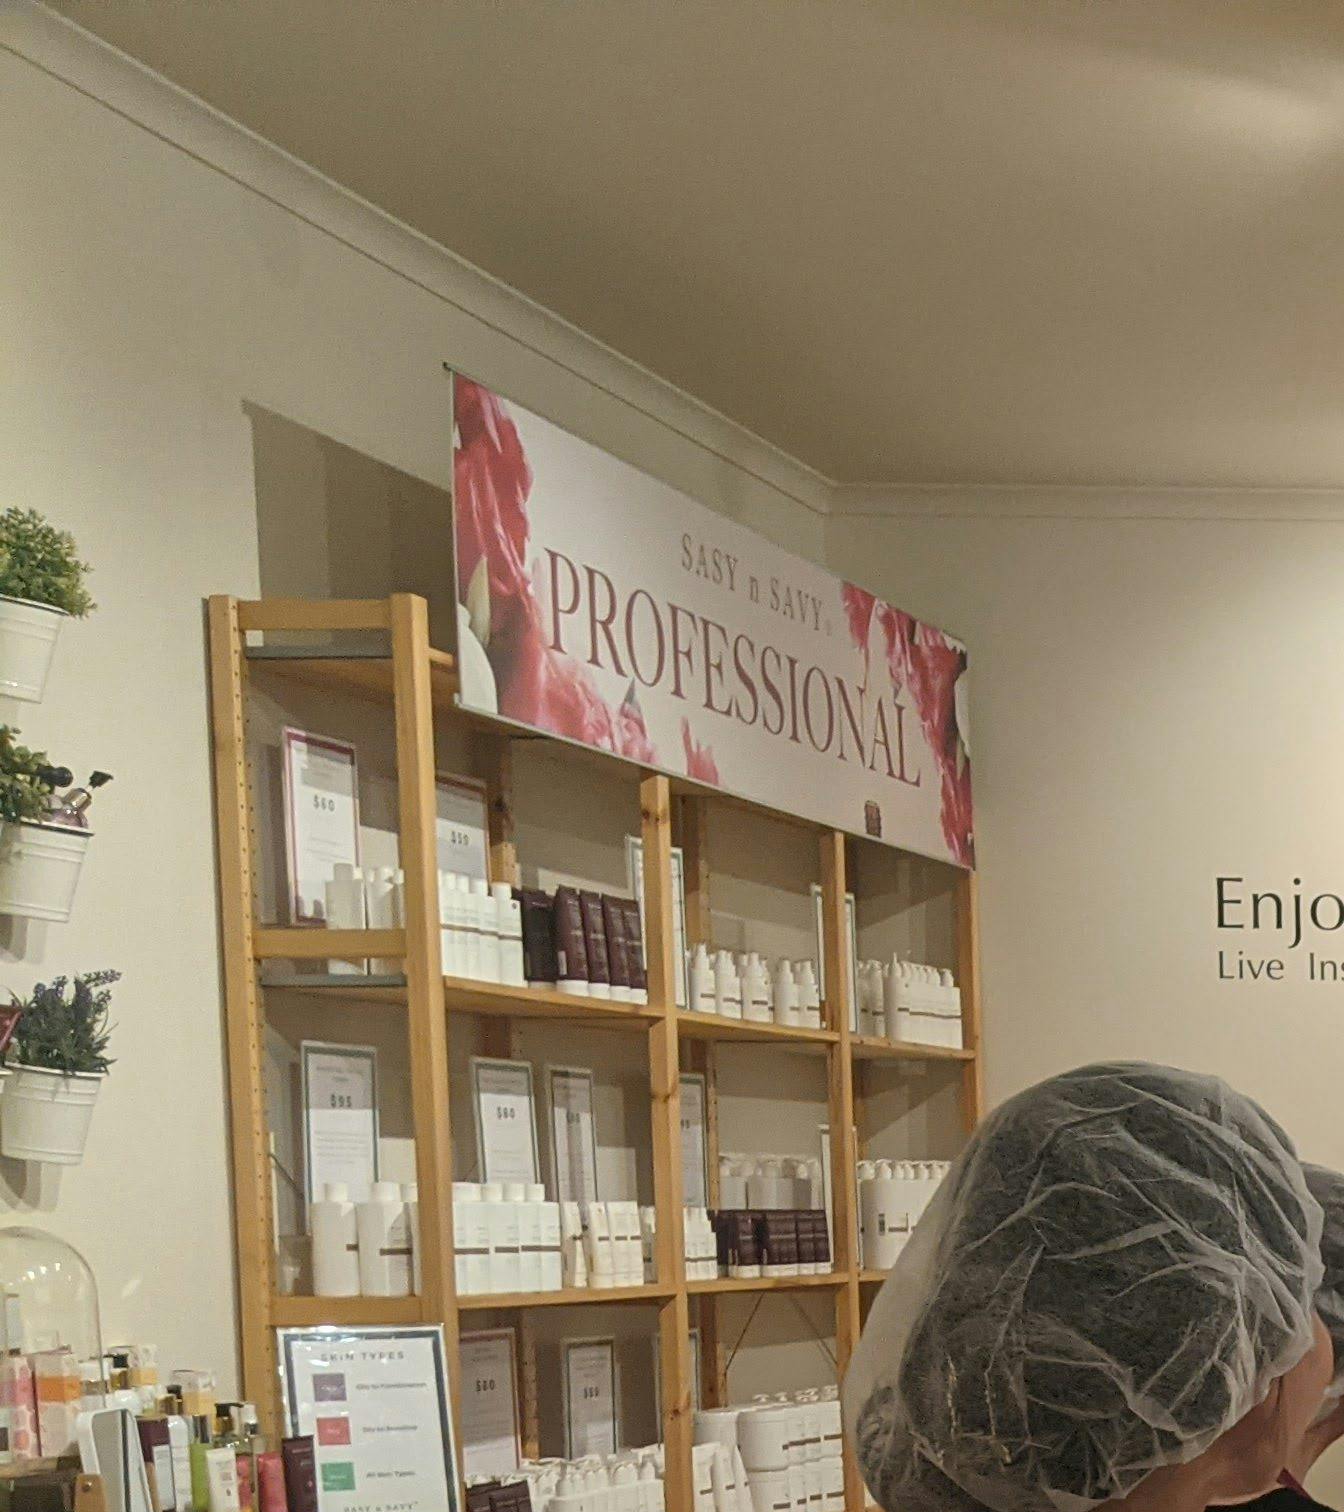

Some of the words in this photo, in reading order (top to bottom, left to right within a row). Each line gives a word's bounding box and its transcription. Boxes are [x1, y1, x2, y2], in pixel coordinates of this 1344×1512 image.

[681, 533, 738, 592] SASY
[544, 547, 922, 788] PROFESSIONAL
[1217, 950, 1285, 982] Live
